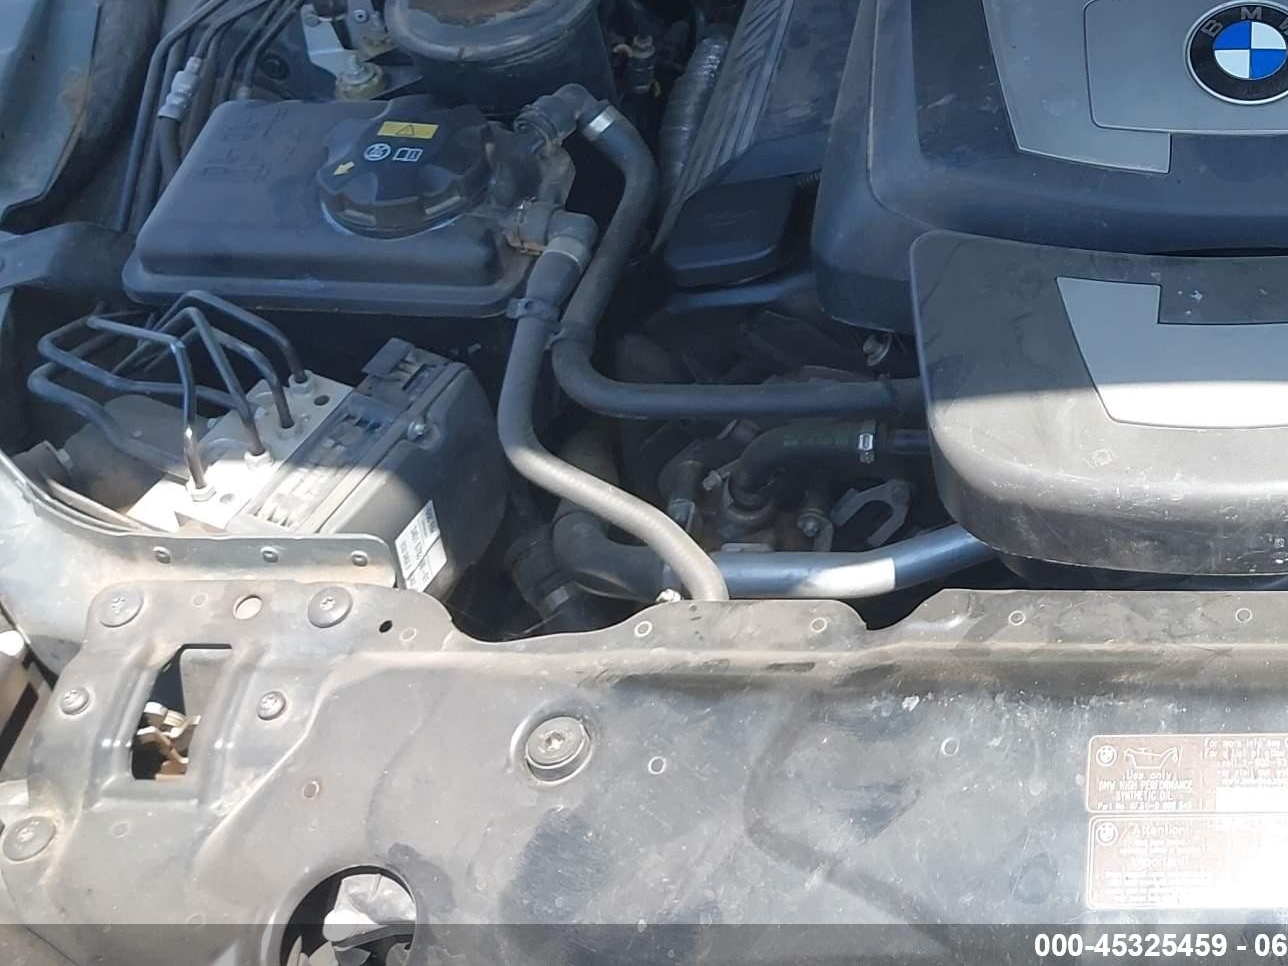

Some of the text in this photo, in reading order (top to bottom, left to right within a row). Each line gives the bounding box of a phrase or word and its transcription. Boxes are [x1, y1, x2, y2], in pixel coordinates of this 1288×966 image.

[1126, 769, 1173, 782] Use only
[1119, 780, 1138, 791] HIGH
[1140, 780, 1193, 791] PERFORMANCE
[1115, 790, 1173, 802] SYNTHETIC OIL
